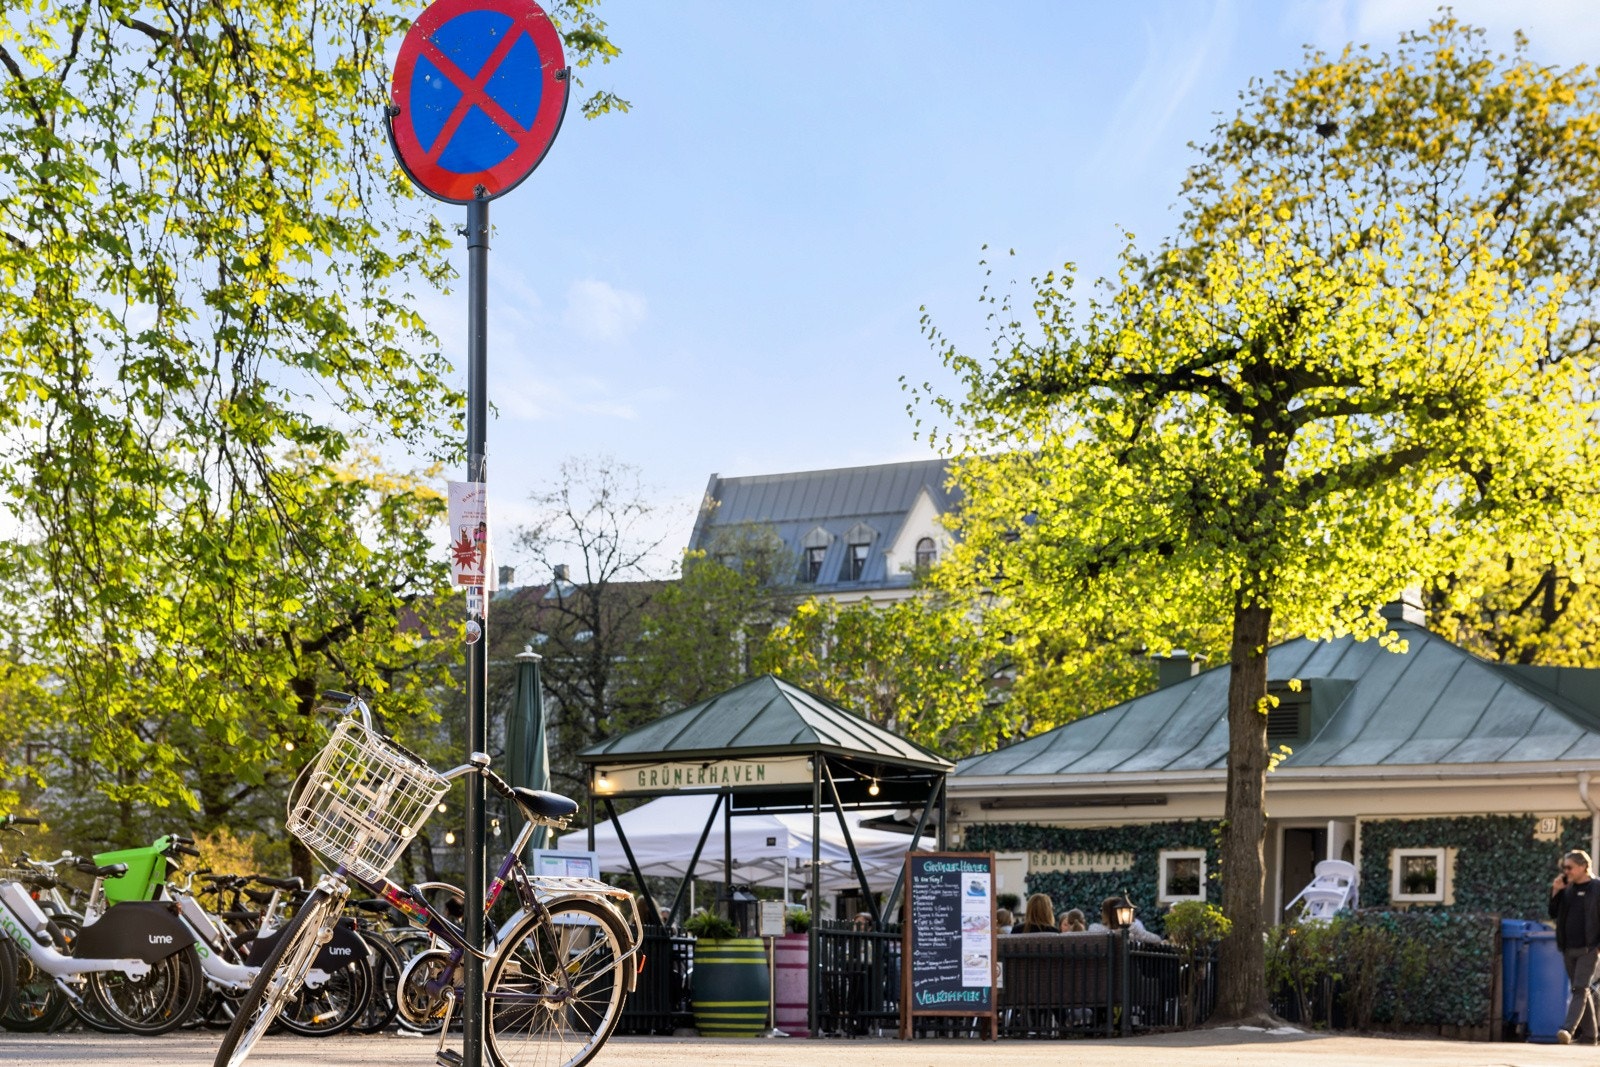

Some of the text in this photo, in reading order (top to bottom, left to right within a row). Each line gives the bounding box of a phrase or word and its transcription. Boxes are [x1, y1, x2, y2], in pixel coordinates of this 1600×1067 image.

[638, 764, 766, 786] GRÜNERHAVEN
[148, 934, 173, 945] Lime
[329, 946, 352, 956] Lime
